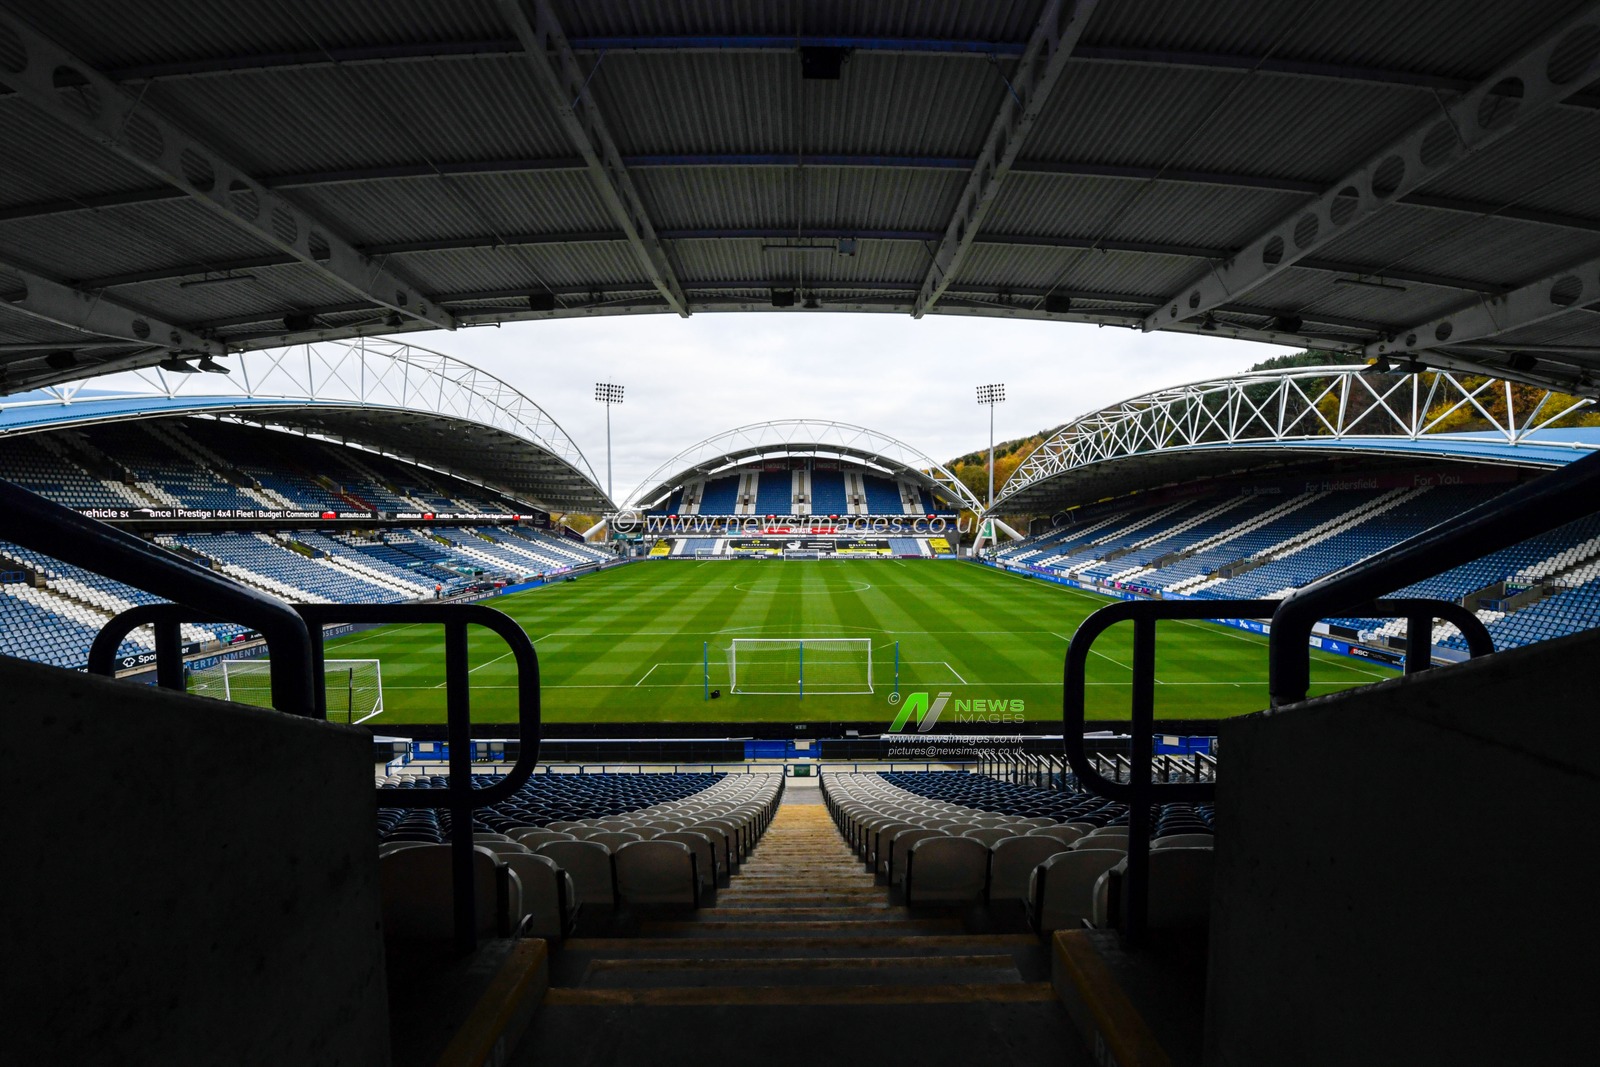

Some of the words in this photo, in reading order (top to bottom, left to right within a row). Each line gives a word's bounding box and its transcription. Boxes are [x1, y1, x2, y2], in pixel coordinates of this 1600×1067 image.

[1413, 475, 1433, 486] For
[1438, 473, 1464, 485] You.
[1305, 482, 1319, 492] For
[178, 509, 212, 520] Prestige
[216, 509, 232, 518] 4x4
[236, 510, 255, 518] Fleet
[258, 510, 282, 520] Budget
[285, 510, 320, 519] Commercial
[335, 624, 354, 635] SUITE
[193, 648, 258, 669] ERTAINMENT
